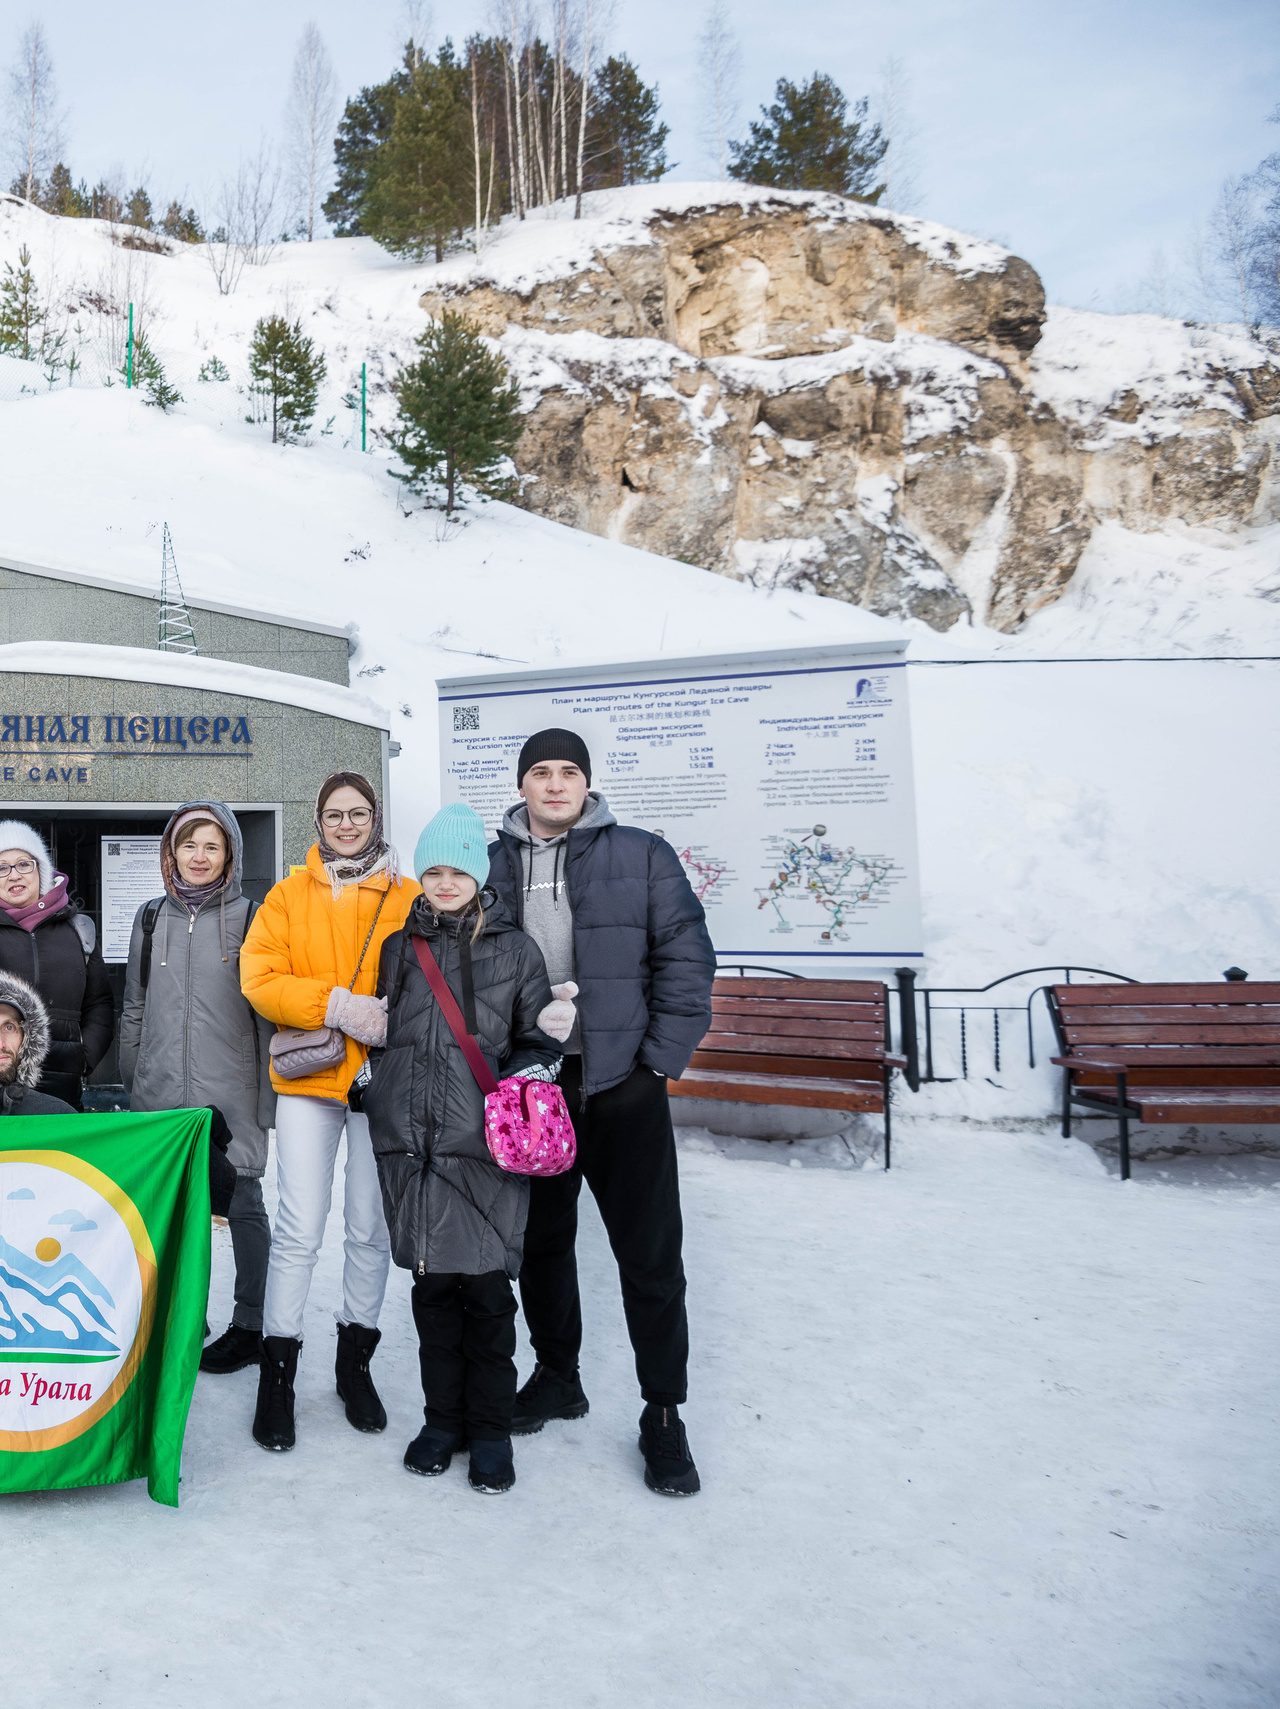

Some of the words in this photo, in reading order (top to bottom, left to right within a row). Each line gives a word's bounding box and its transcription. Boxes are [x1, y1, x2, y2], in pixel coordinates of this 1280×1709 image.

[584, 694, 631, 702] маршруты
[633, 689, 686, 700] Кунгурской
[689, 686, 730, 695] Ледяной
[732, 684, 772, 692] пещеры
[727, 696, 749, 704] Cave
[104, 716, 253, 750] ПЕЩЕРА
[777, 724, 821, 732] Individual
[823, 722, 866, 730] excursion
[452, 736, 490, 744] Экскурсия
[616, 733, 664, 742] Sightseeing
[29, 767, 88, 782] CAVE
[20, 1373, 92, 1405] Урала
